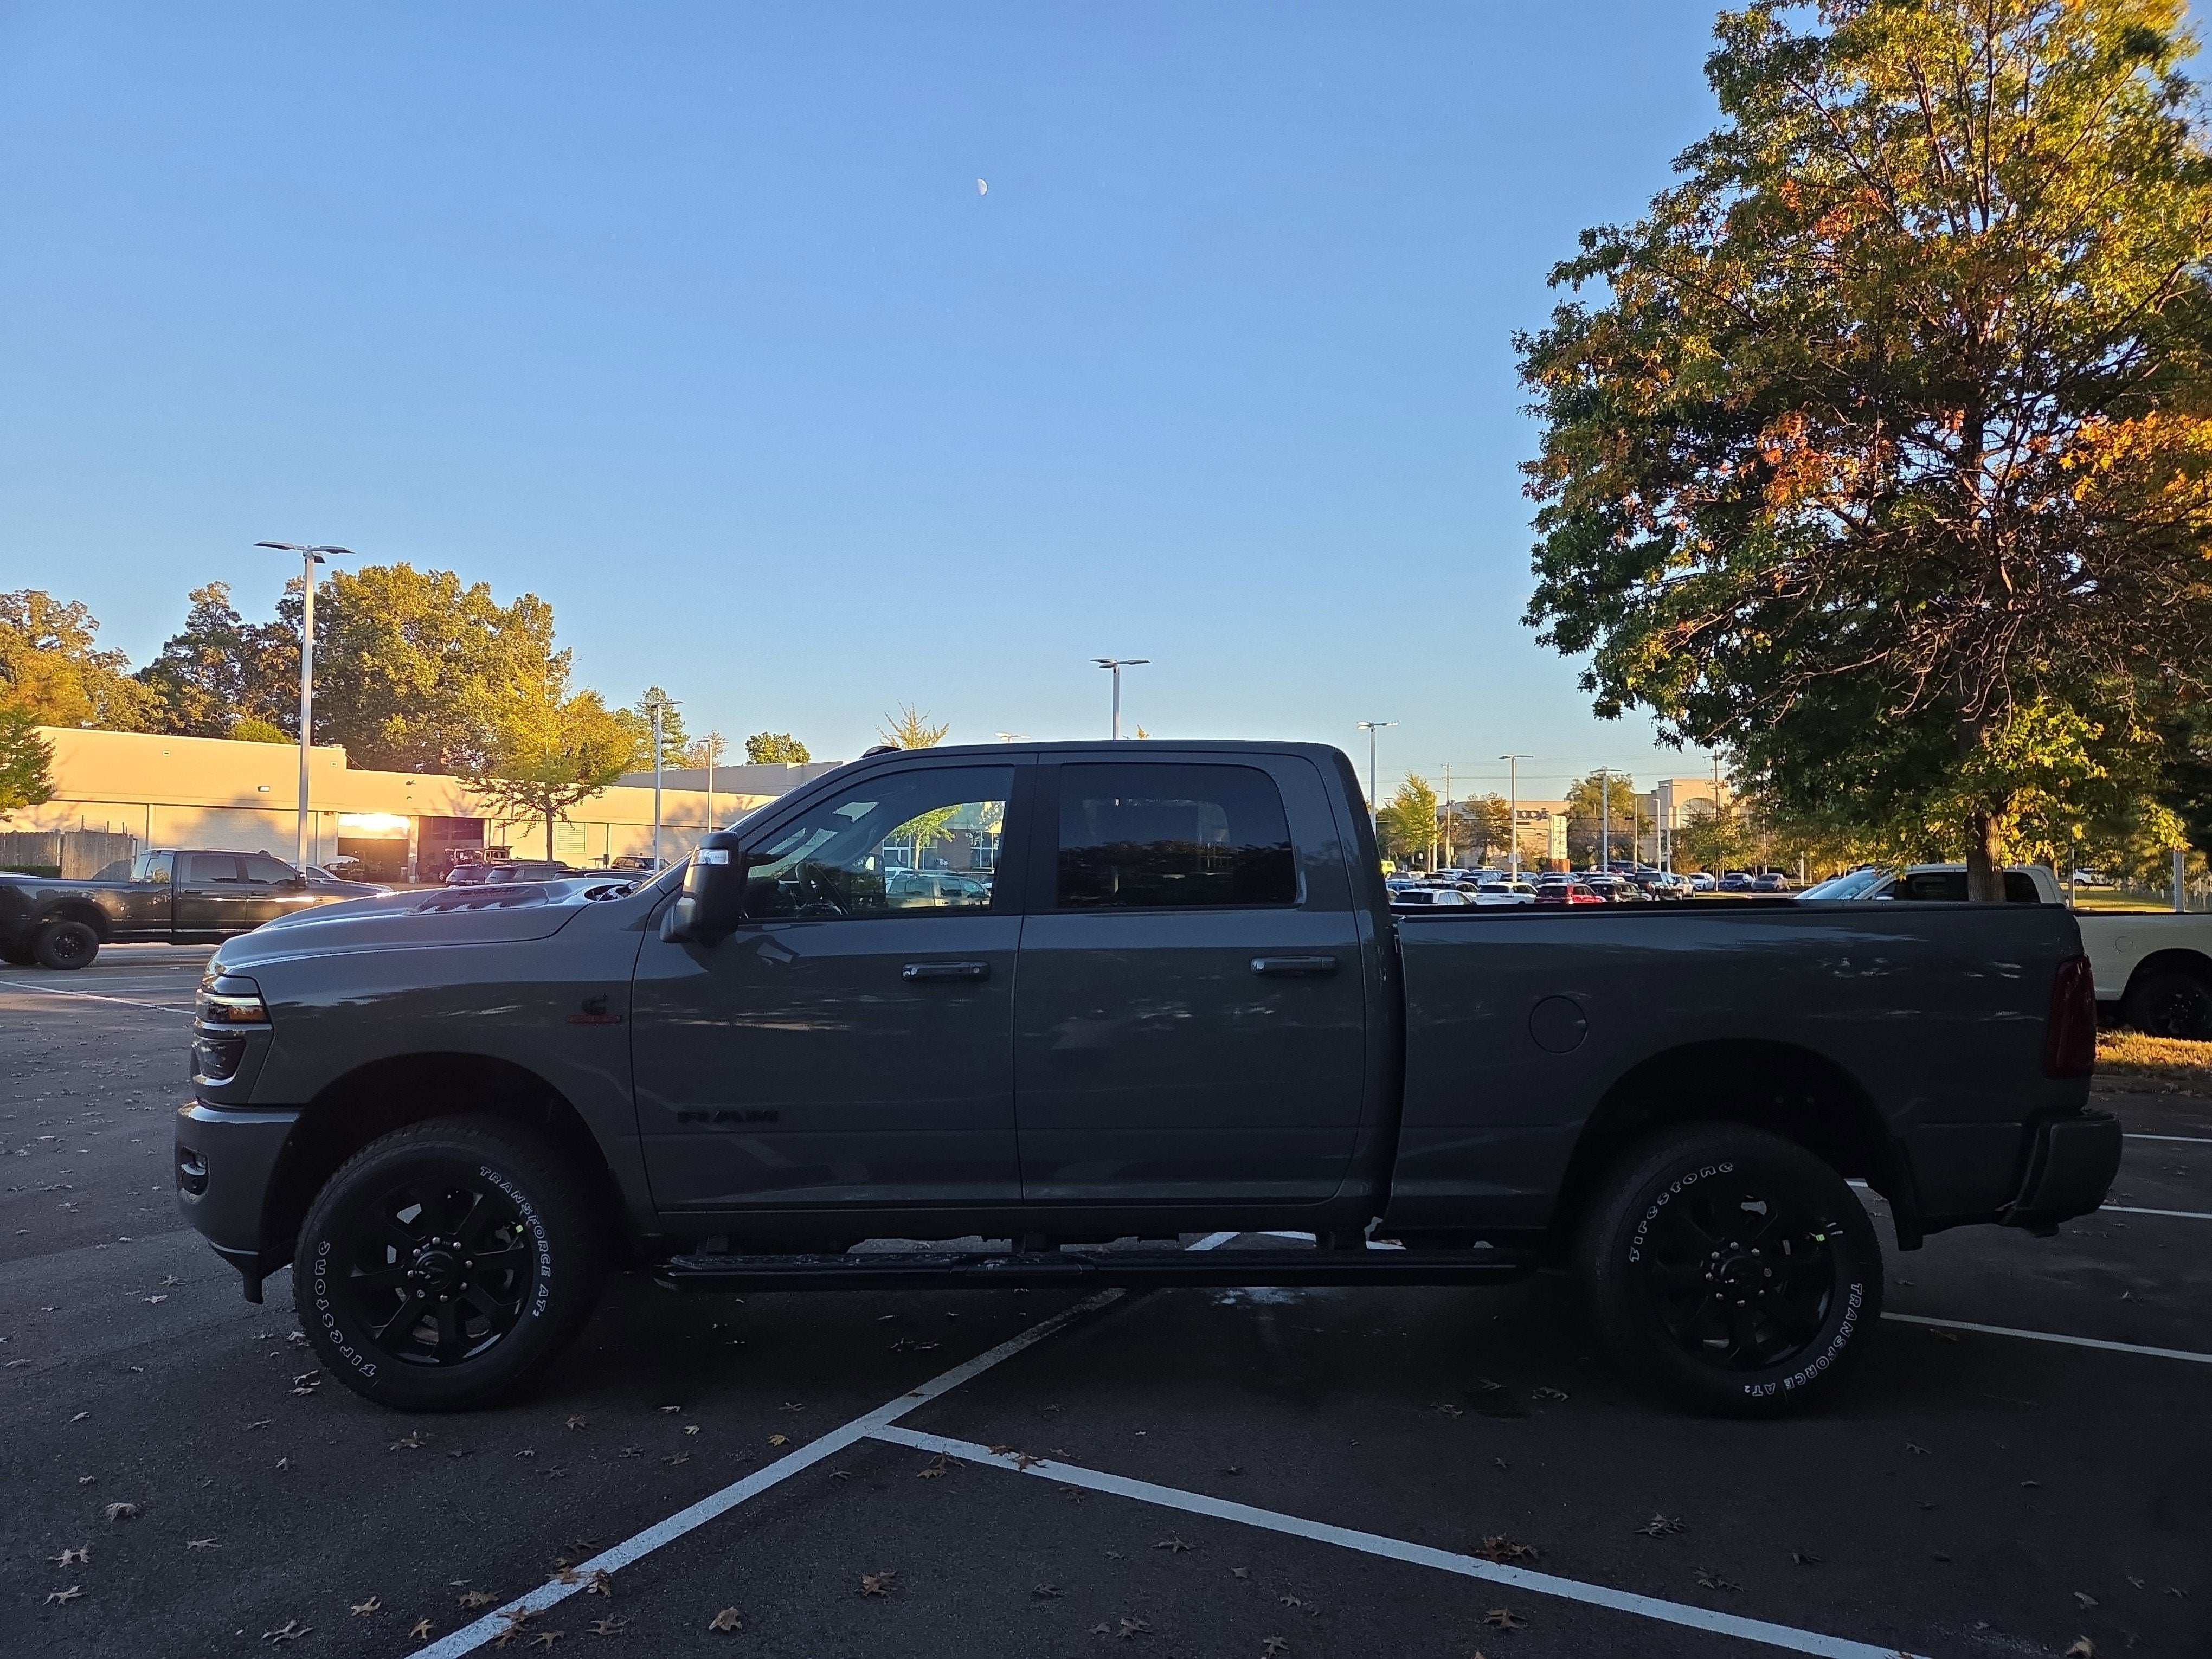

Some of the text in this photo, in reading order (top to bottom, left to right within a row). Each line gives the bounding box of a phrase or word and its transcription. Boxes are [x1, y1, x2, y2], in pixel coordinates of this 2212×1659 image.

[678, 1110, 779, 1123] RAM
[480, 1166, 551, 1277] TRANSFORCE
[1784, 1283, 1863, 1390] TRANSFORCE
